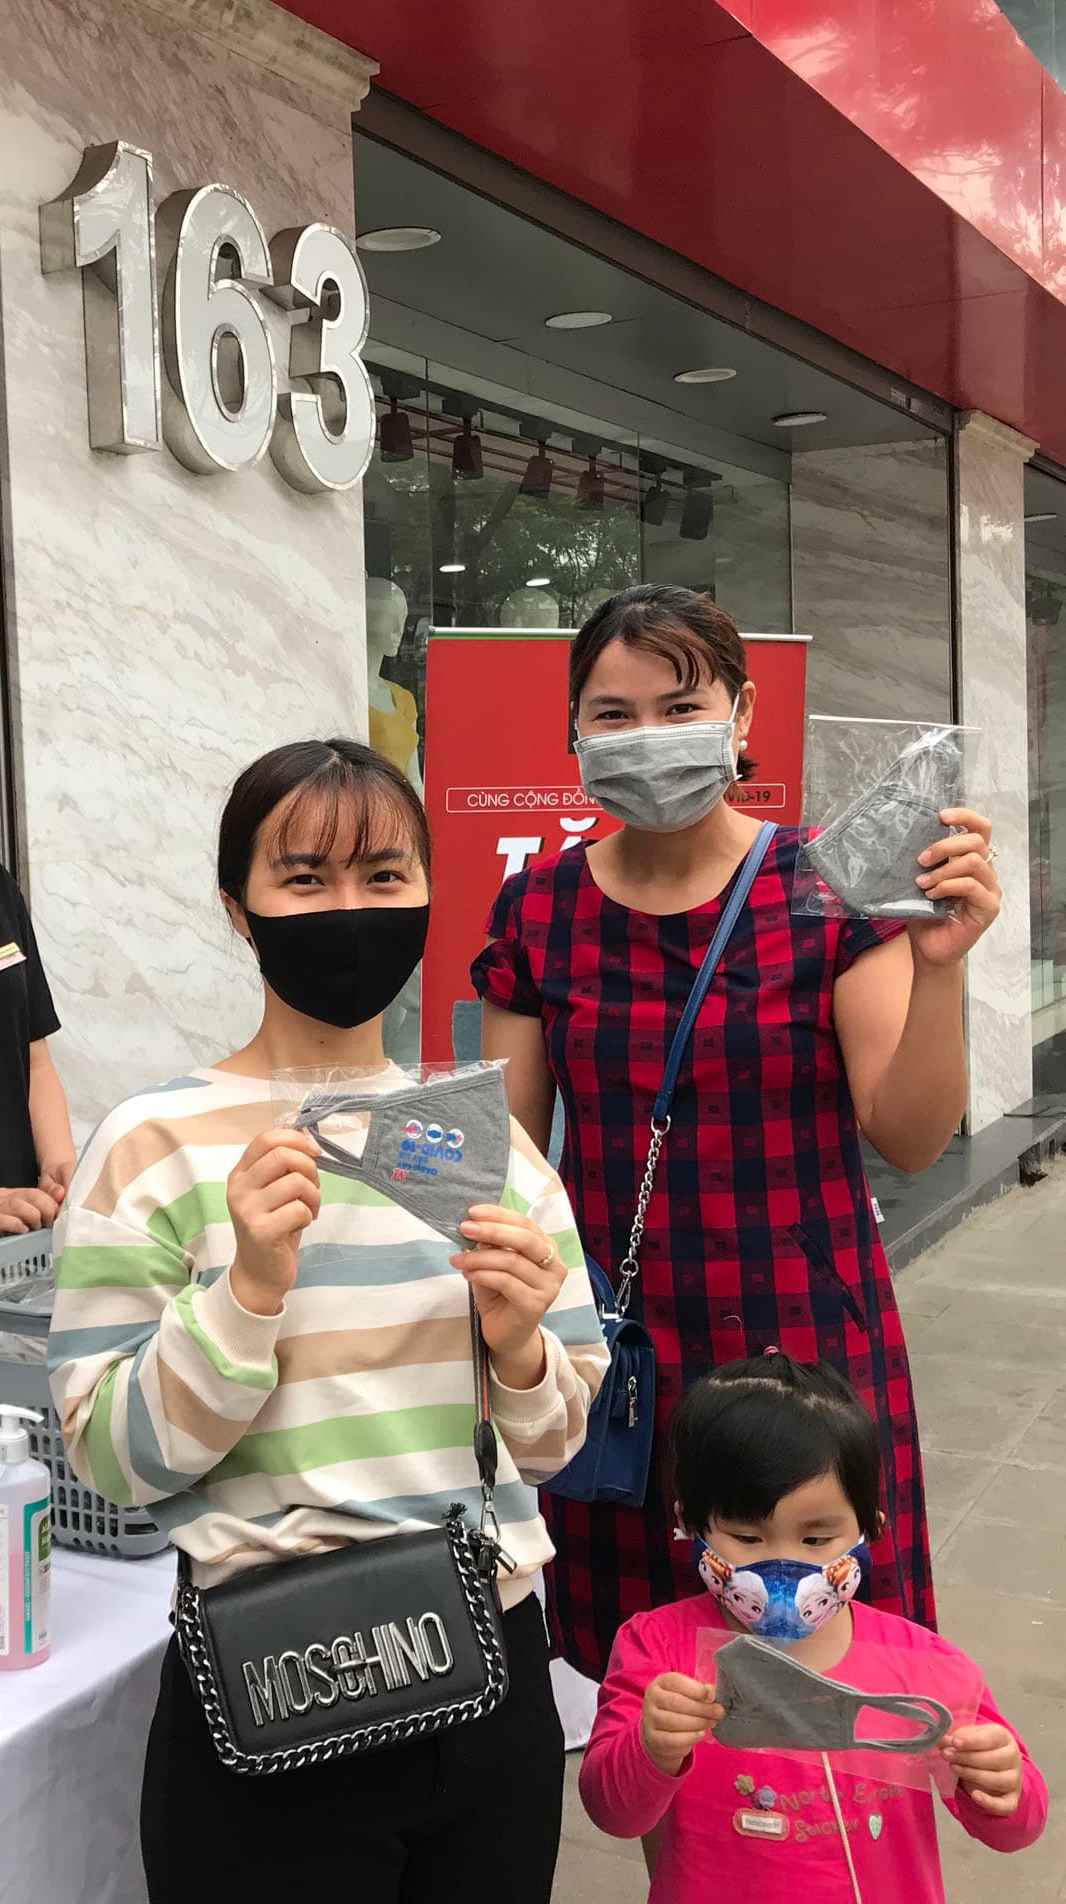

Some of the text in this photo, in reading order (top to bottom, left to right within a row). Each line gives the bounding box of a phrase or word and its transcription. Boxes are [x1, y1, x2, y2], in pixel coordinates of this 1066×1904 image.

[70, 140, 377, 491] 163
[466, 791, 510, 807] CÙNG
[513, 790, 559, 808] CỘNG
[562, 787, 599, 806] ĐỒN
[242, 1611, 454, 1727] MOSCHINO
